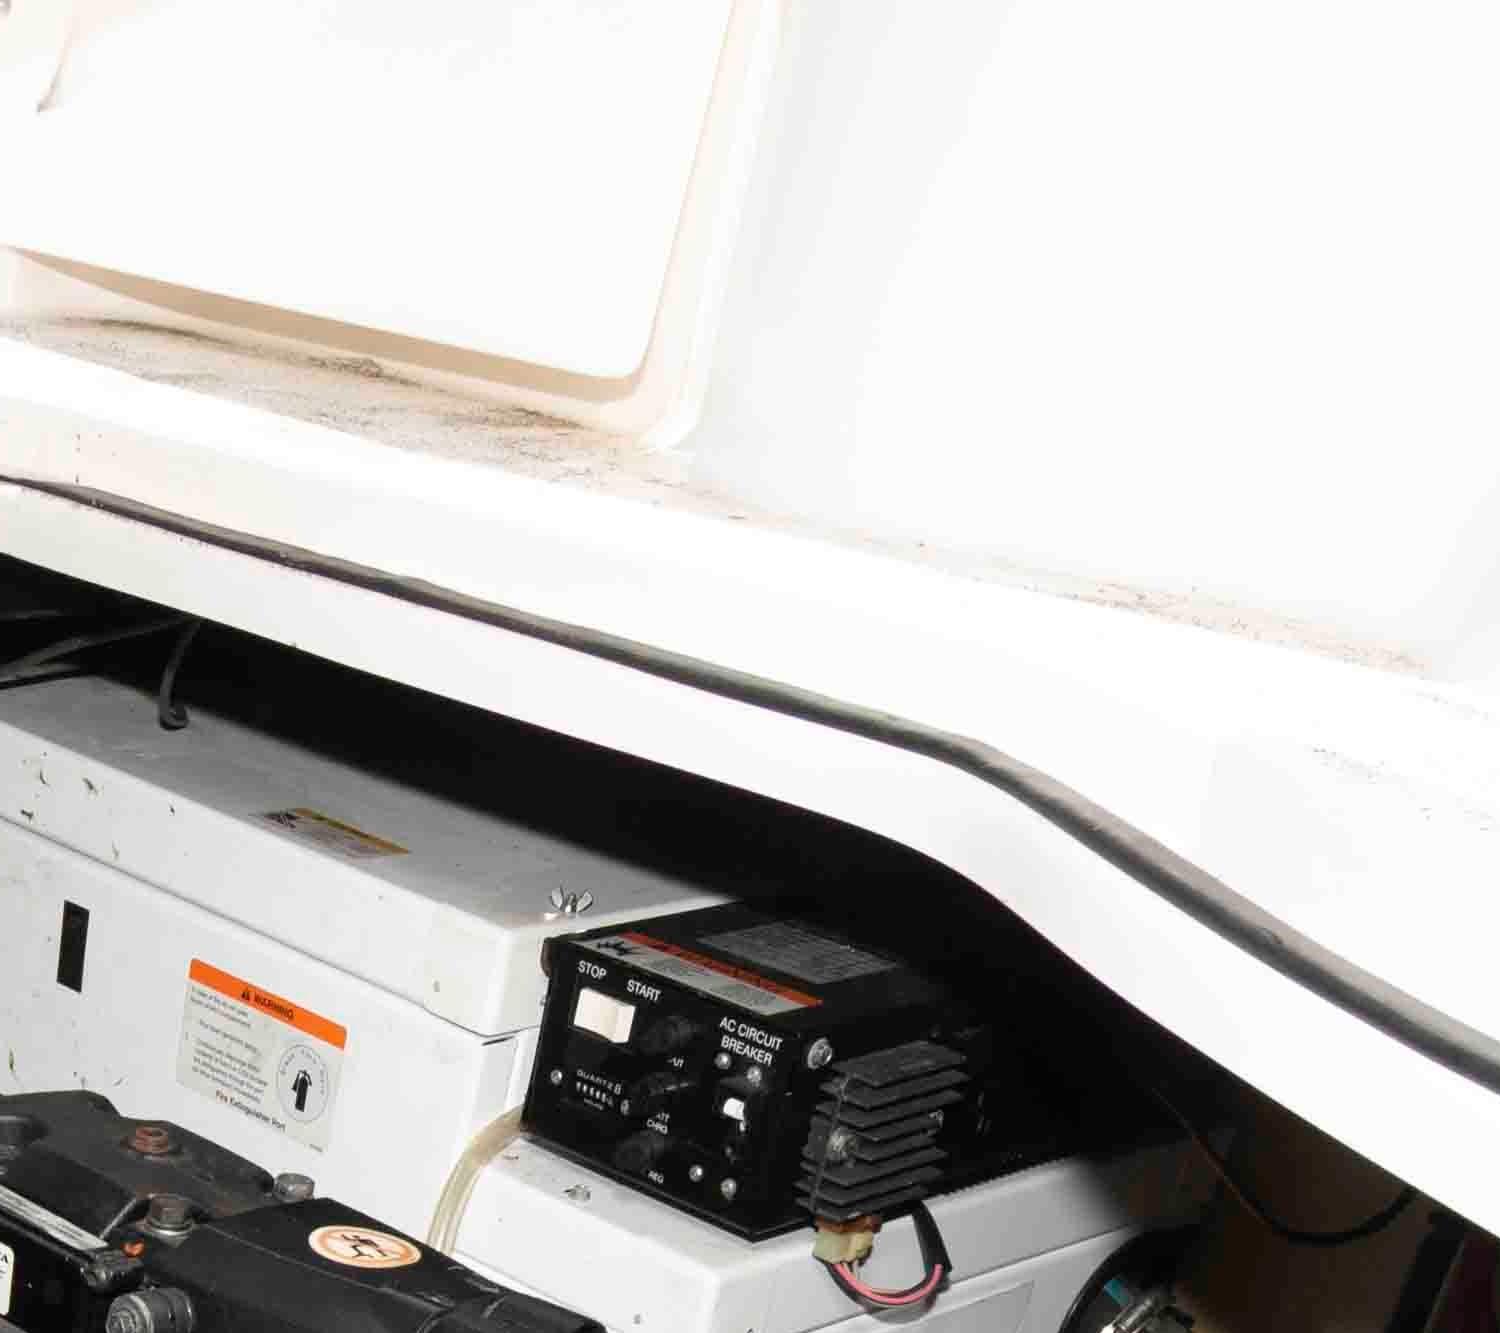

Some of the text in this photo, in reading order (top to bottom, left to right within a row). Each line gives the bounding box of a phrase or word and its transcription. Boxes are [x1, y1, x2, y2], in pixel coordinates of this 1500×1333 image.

[577, 960, 607, 981] STOP
[626, 979, 662, 1002] START
[719, 1017, 784, 1052] AC CIRCUIT
[720, 1035, 774, 1066] BREAKER
